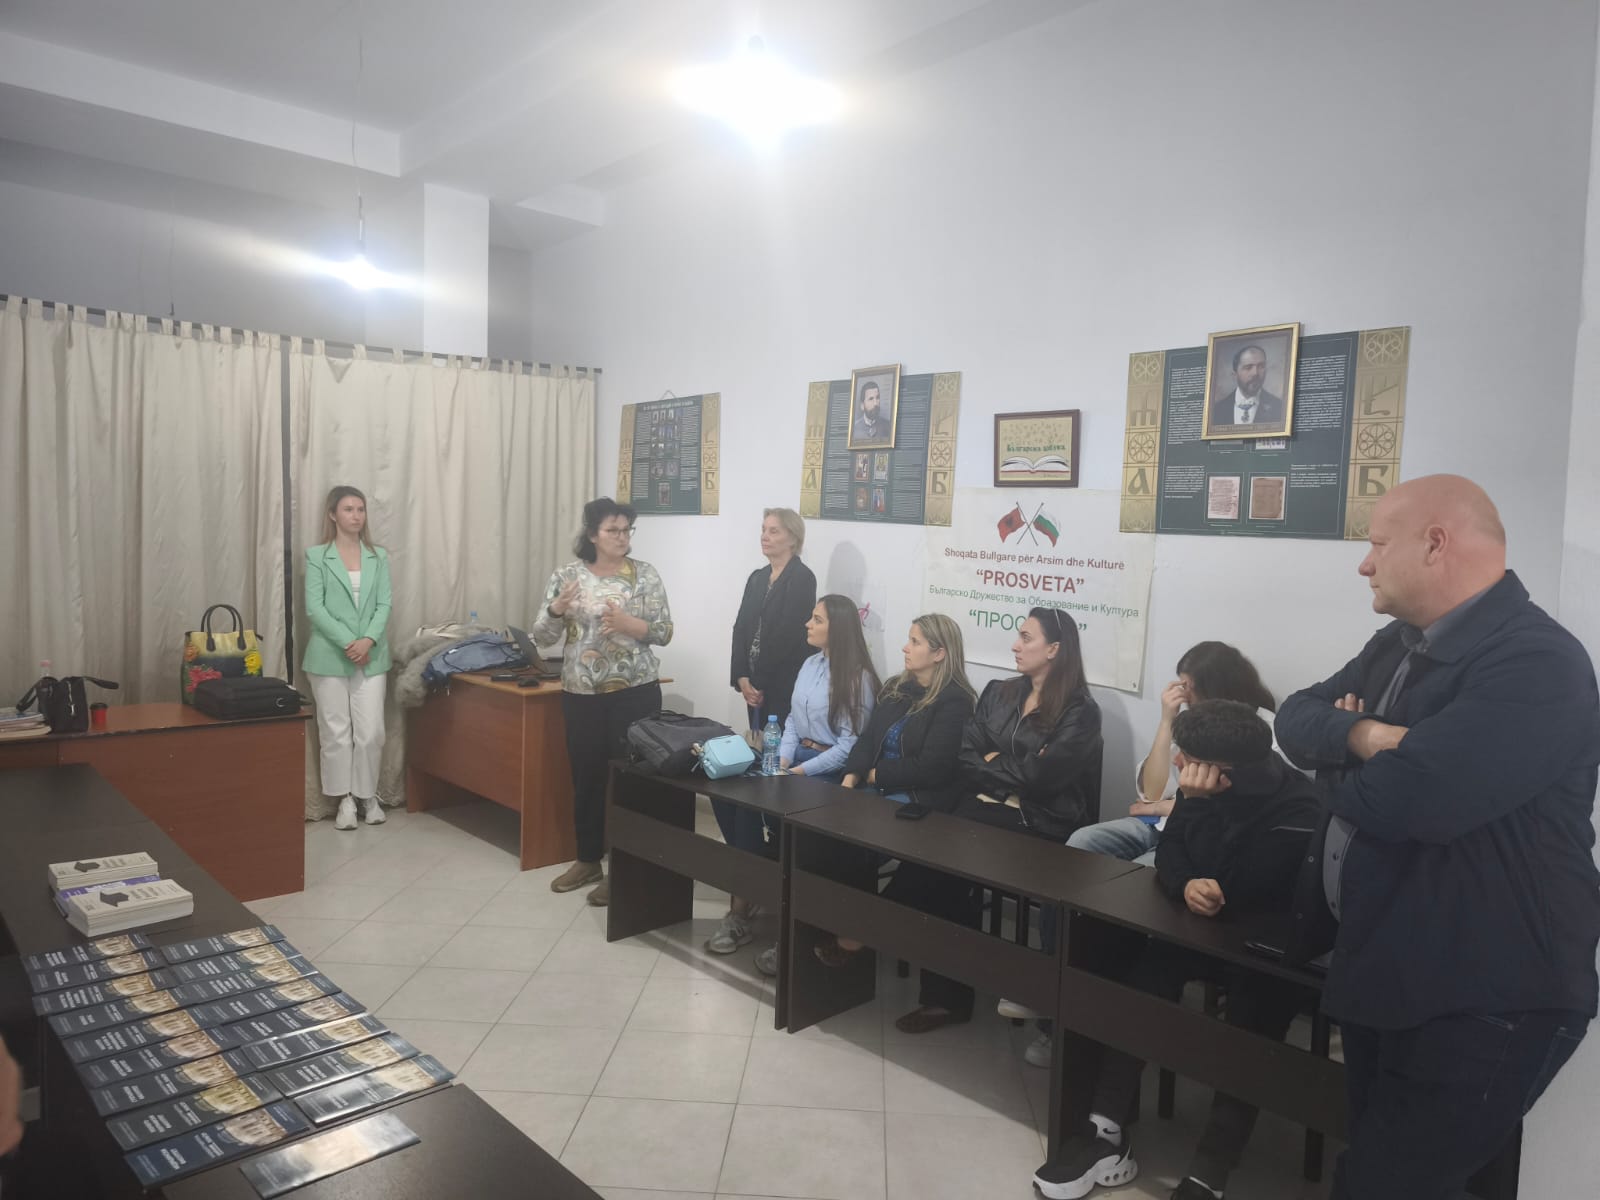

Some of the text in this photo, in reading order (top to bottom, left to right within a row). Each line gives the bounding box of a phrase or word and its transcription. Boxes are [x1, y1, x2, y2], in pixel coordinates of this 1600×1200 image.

[944, 548, 1125, 570] Shoqata Bullgare për Arsim dhe Kulturë
[976, 569, 1085, 594] “PROSVETA”
[929, 584, 1139, 618] Българско Дружество за Образование и Култура
